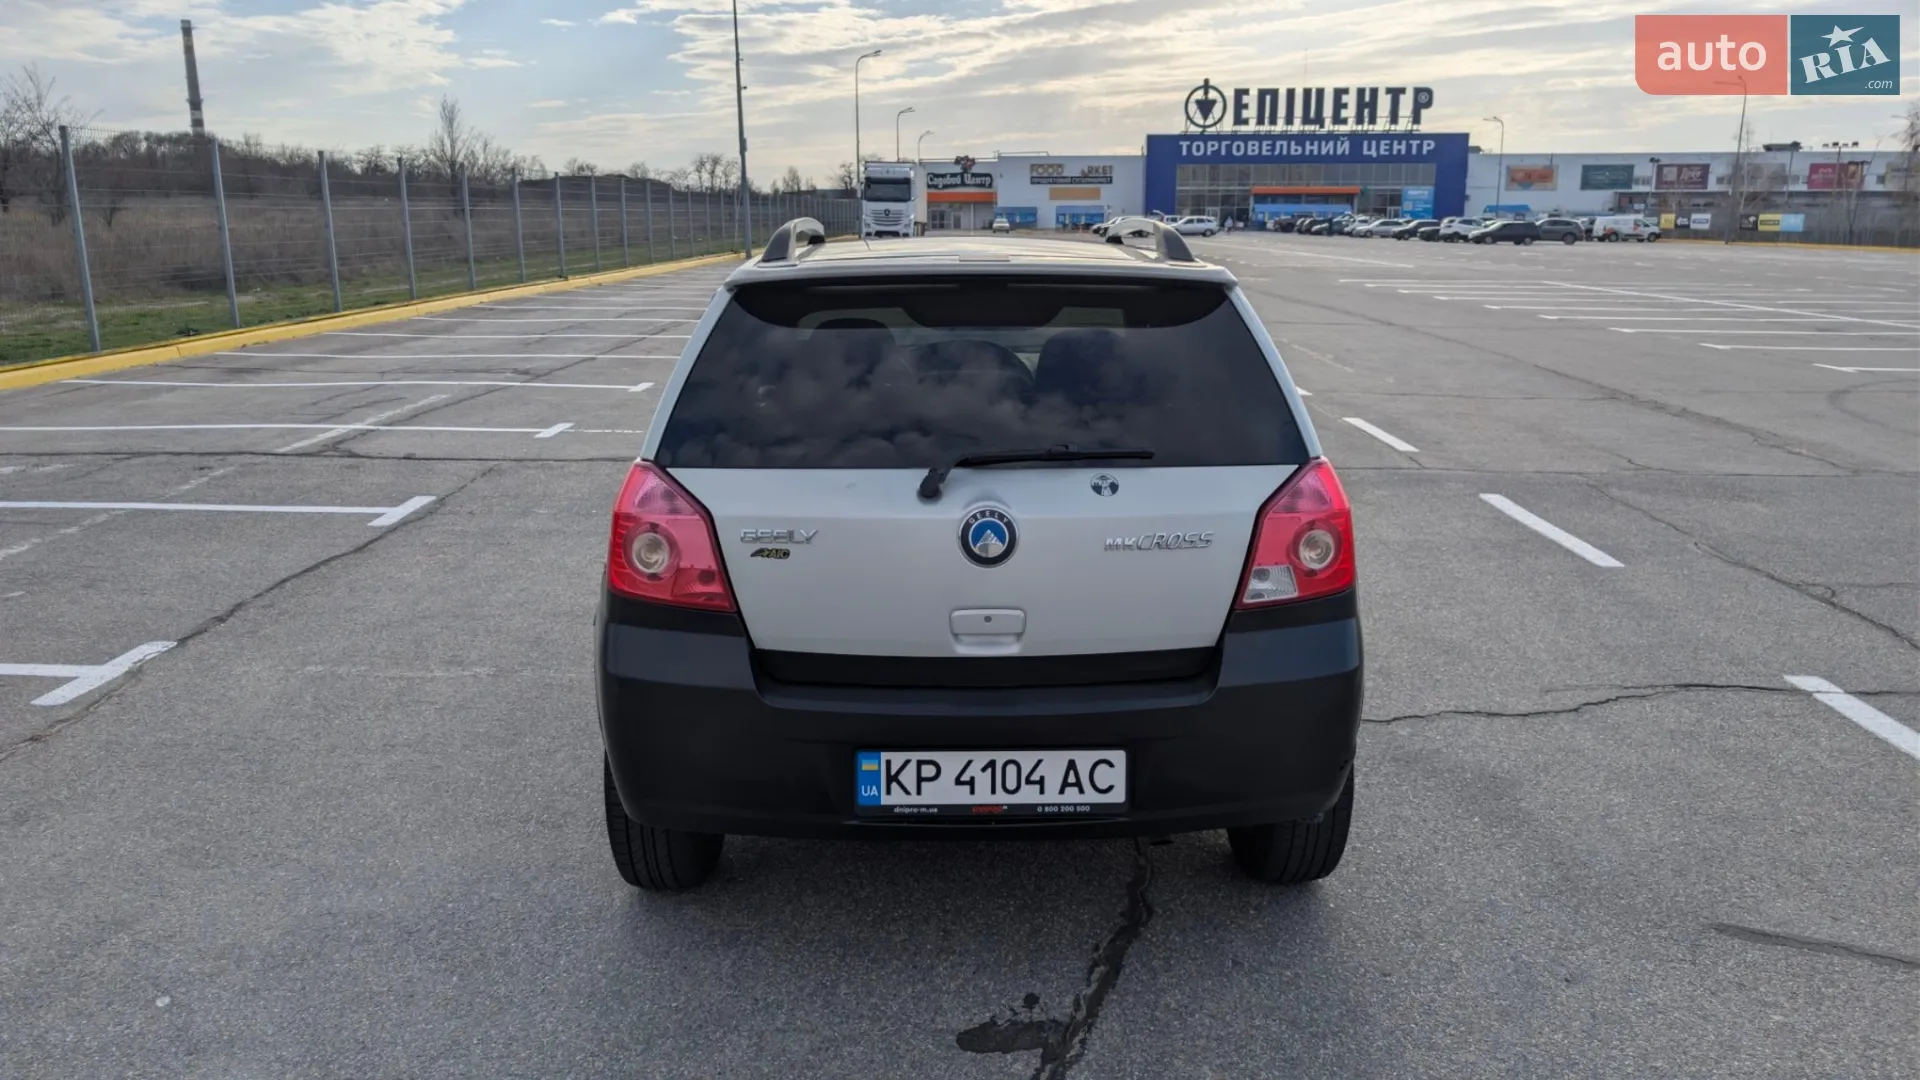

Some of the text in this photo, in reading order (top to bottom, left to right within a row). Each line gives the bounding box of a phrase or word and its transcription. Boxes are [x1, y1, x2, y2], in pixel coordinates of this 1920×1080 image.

[1233, 87, 1434, 129] ЕПІЦЕНТР
[1179, 137, 1436, 158] ТОРГОВЕЛЬНИЙ ЦЕНТР
[1030, 163, 1064, 176] FOOD
[968, 510, 1009, 524] GEELY
[740, 528, 819, 544] GEELY
[885, 758, 1116, 796] KP 4104 AC
[861, 785, 878, 797] UA
